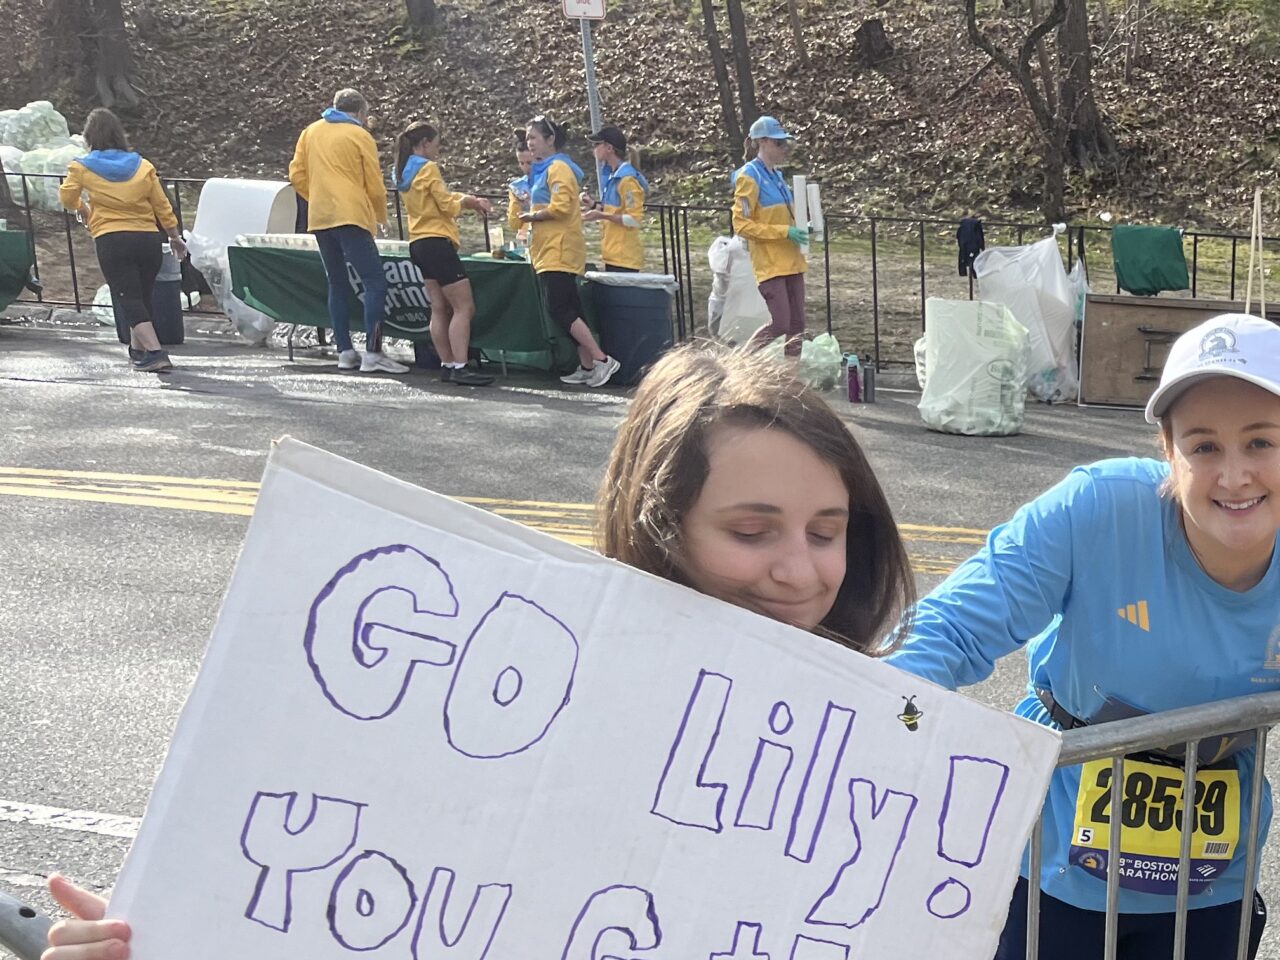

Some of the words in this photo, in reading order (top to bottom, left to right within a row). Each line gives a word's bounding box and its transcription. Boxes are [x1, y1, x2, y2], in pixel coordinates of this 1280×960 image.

[302, 544, 580, 760] GO
[652, 668, 1009, 927] Lily!
[1080, 829, 1092, 843] 5
[1134, 859, 1180, 872] BOSTON
[1106, 866, 1178, 882] ARATHON
